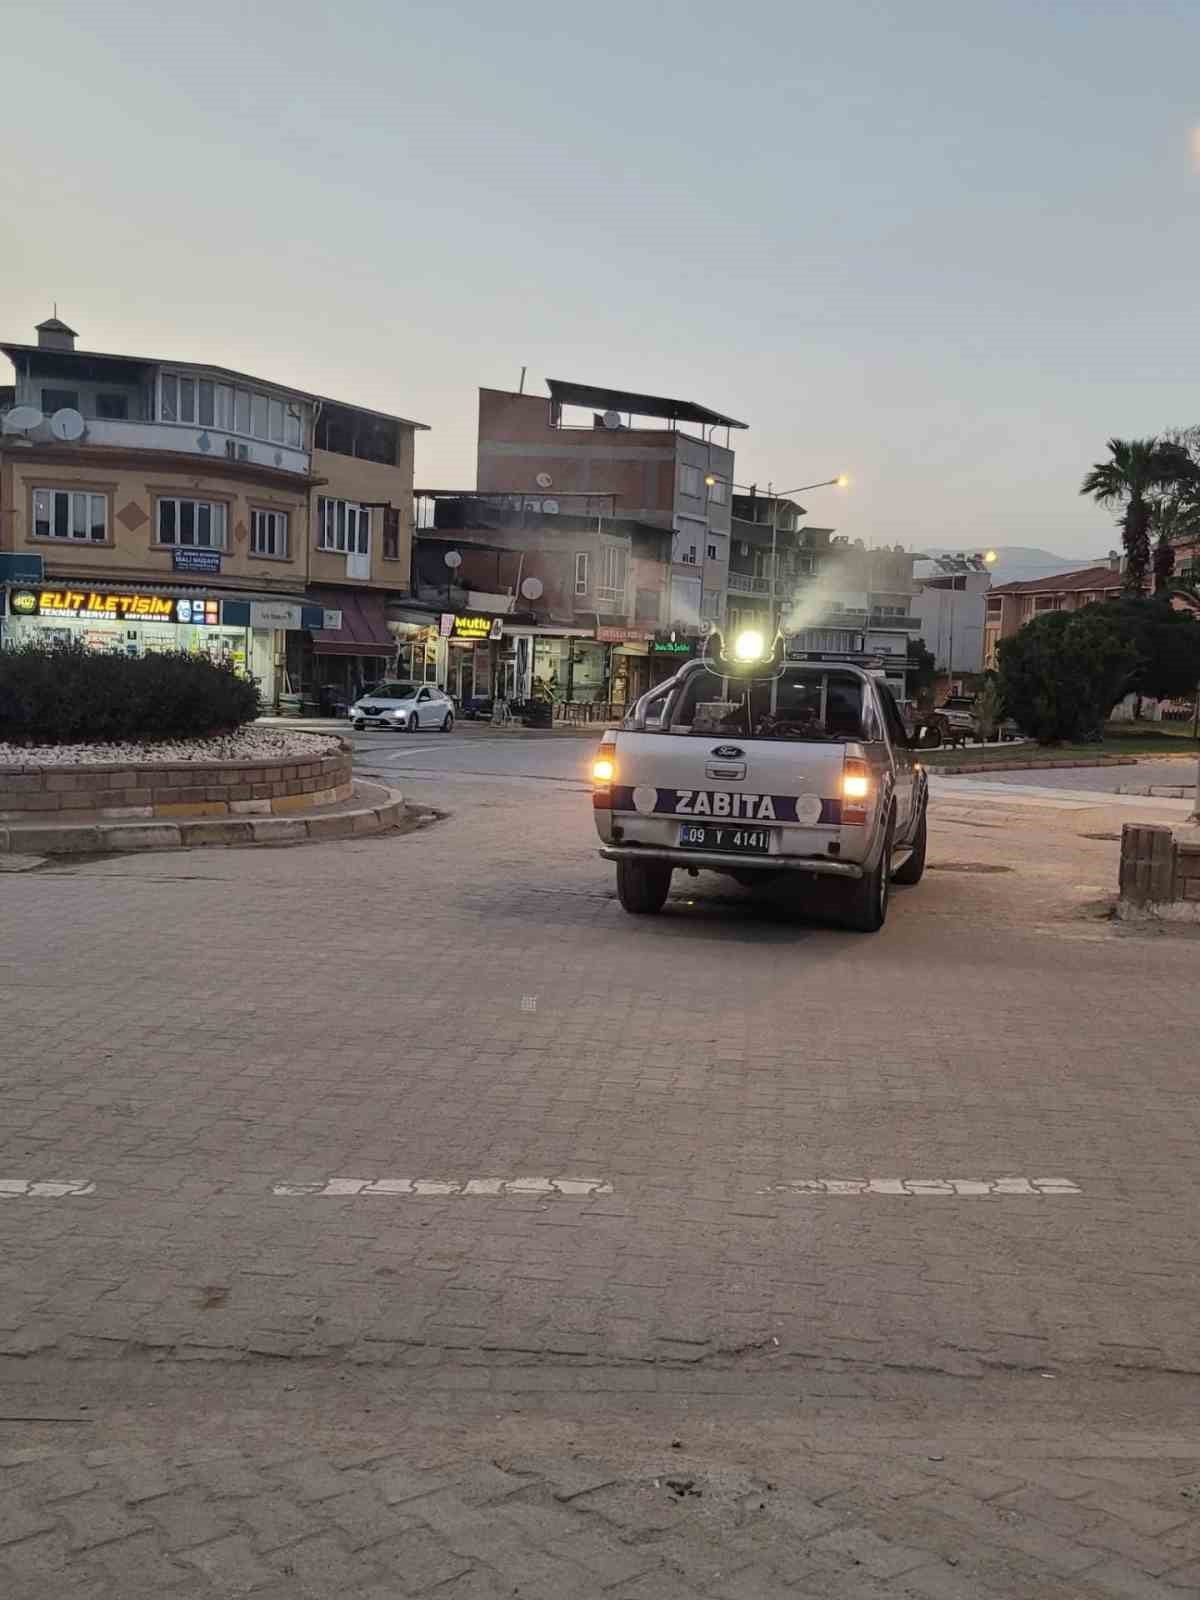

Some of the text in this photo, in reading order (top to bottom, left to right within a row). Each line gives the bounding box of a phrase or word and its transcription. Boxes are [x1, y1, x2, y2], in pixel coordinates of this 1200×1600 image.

[40, 591, 85, 609] ELİT
[88, 593, 173, 614] İLETİŞİM
[40, 608, 78, 617] TEKNİK
[455, 616, 491, 630] Mutlu
[675, 790, 776, 819] ZABITA
[689, 828, 705, 843] 09
[733, 831, 765, 848] 4141
